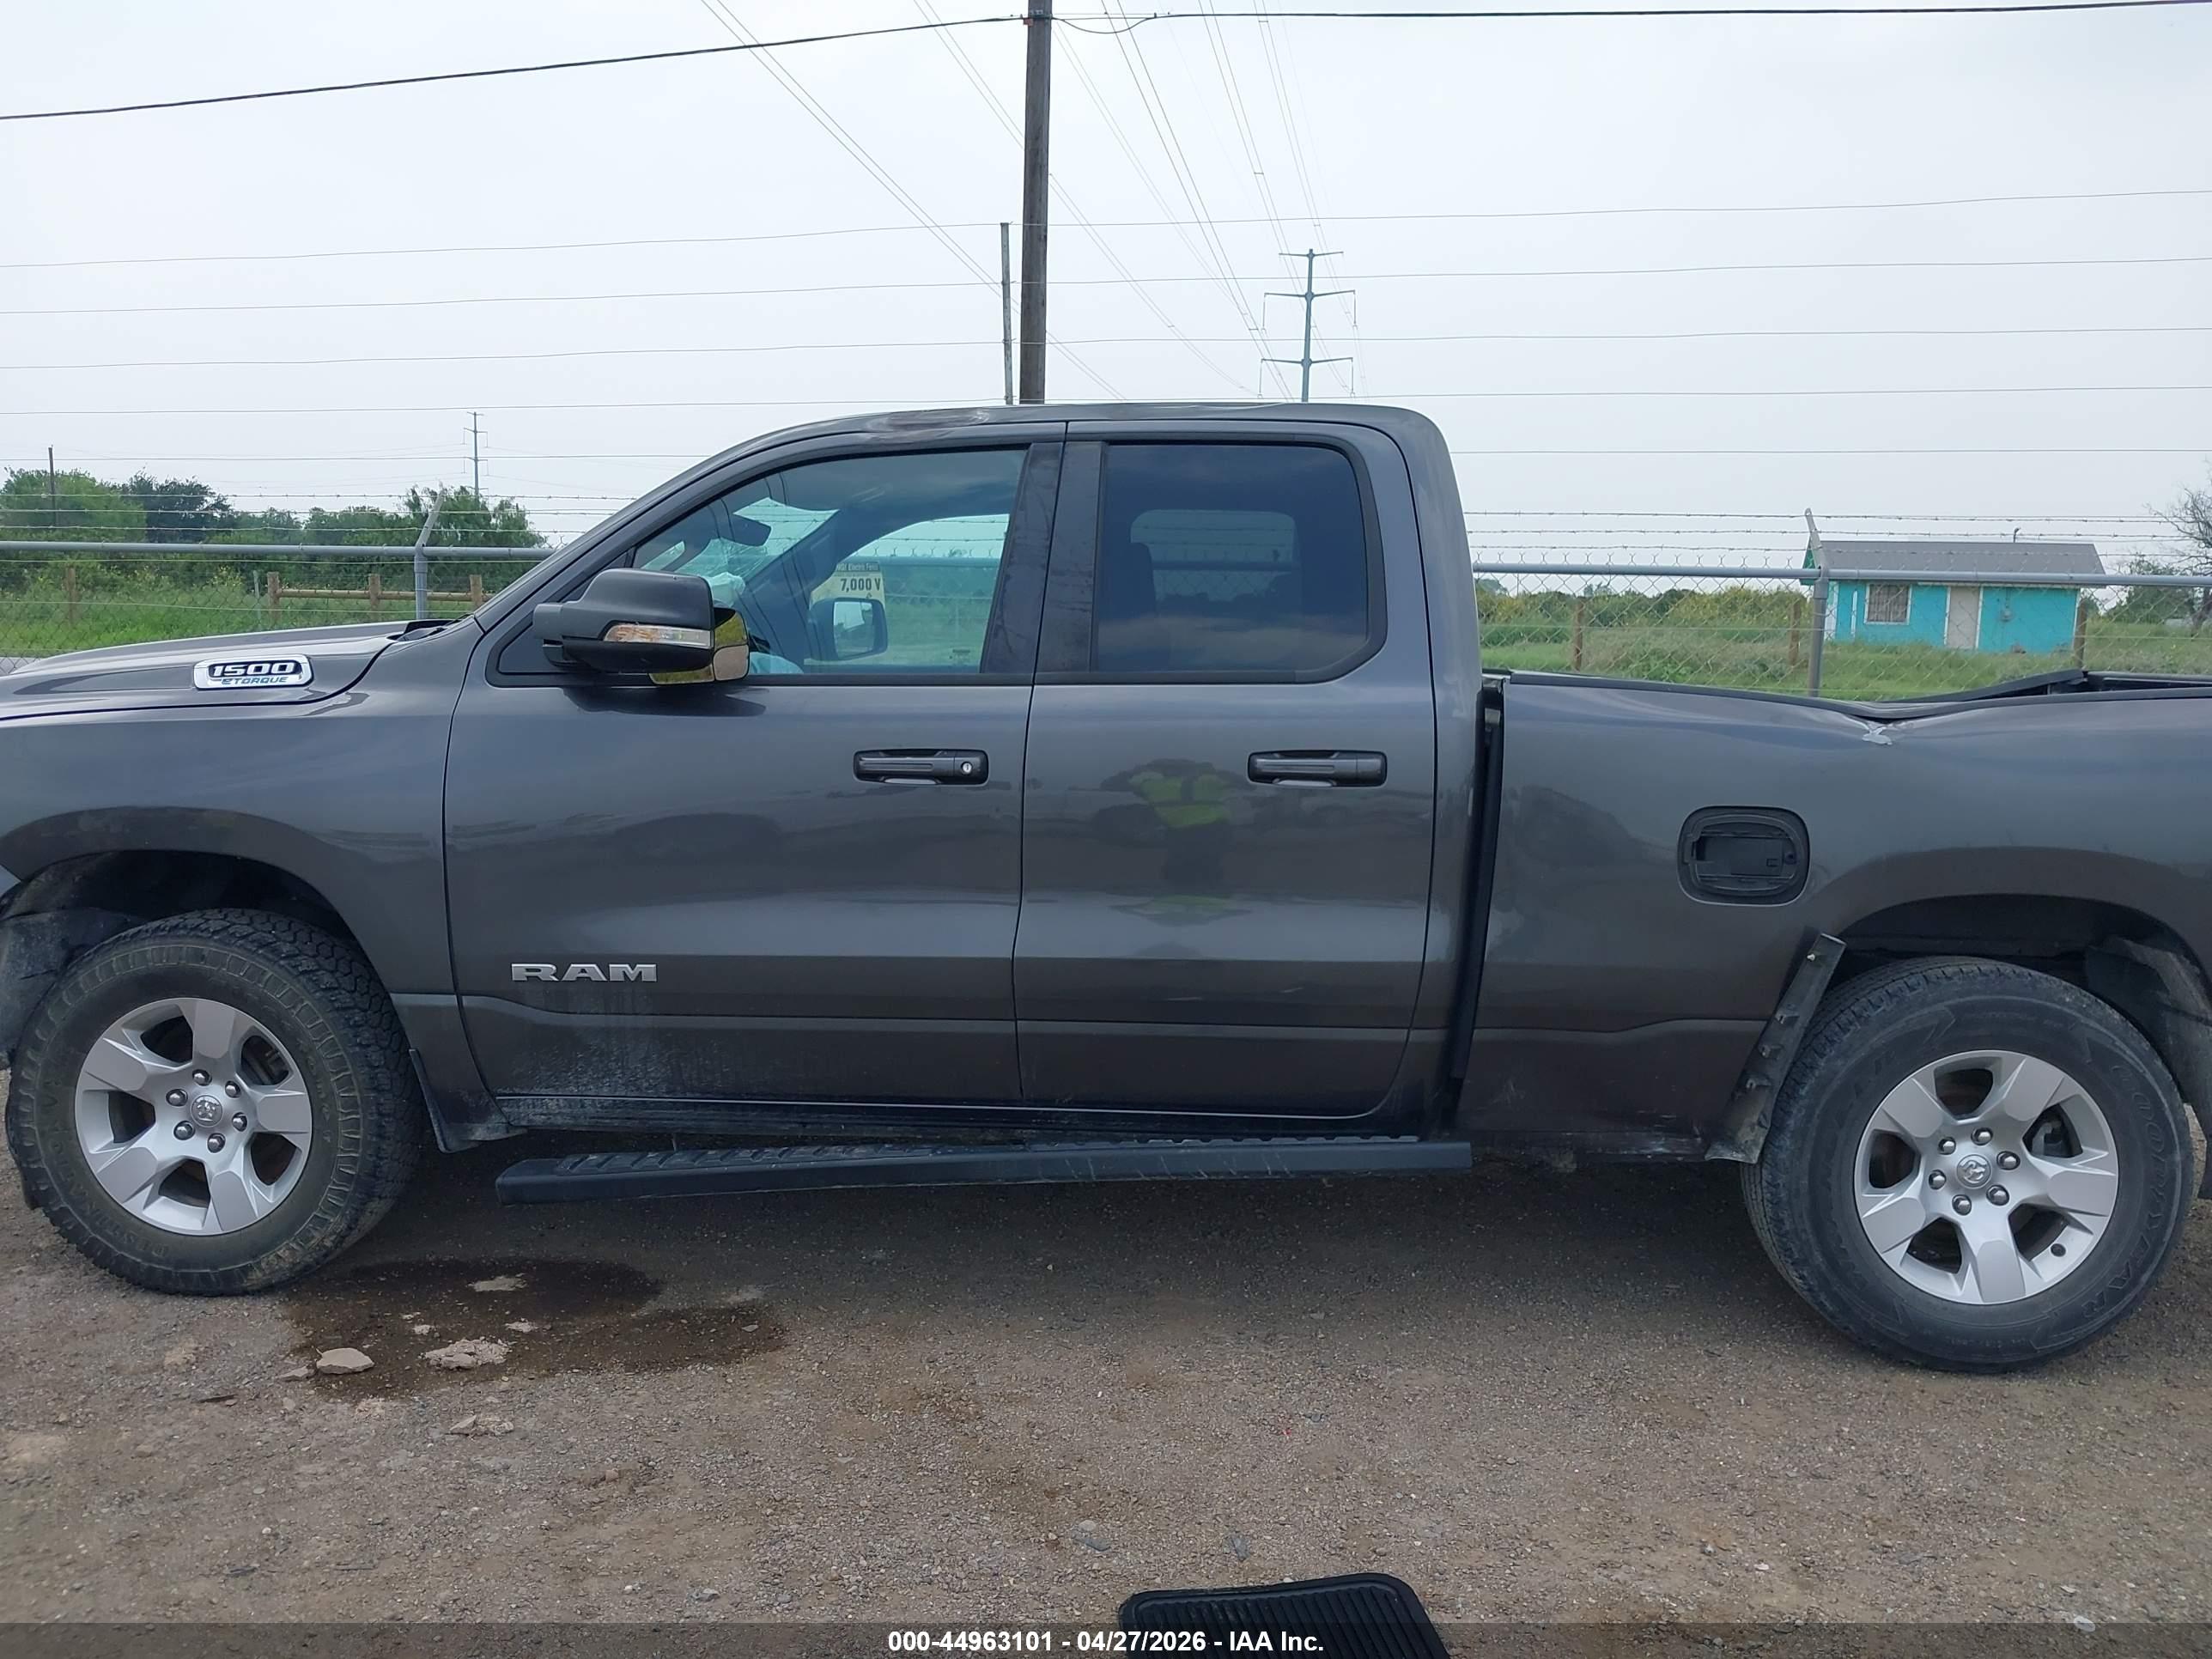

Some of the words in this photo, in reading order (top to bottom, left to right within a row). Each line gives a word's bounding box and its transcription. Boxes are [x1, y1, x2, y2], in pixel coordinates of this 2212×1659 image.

[841, 578, 872, 592] 7,000
[874, 578, 880, 591] V
[213, 662, 295, 677] 1500
[511, 963, 657, 982] RAM
